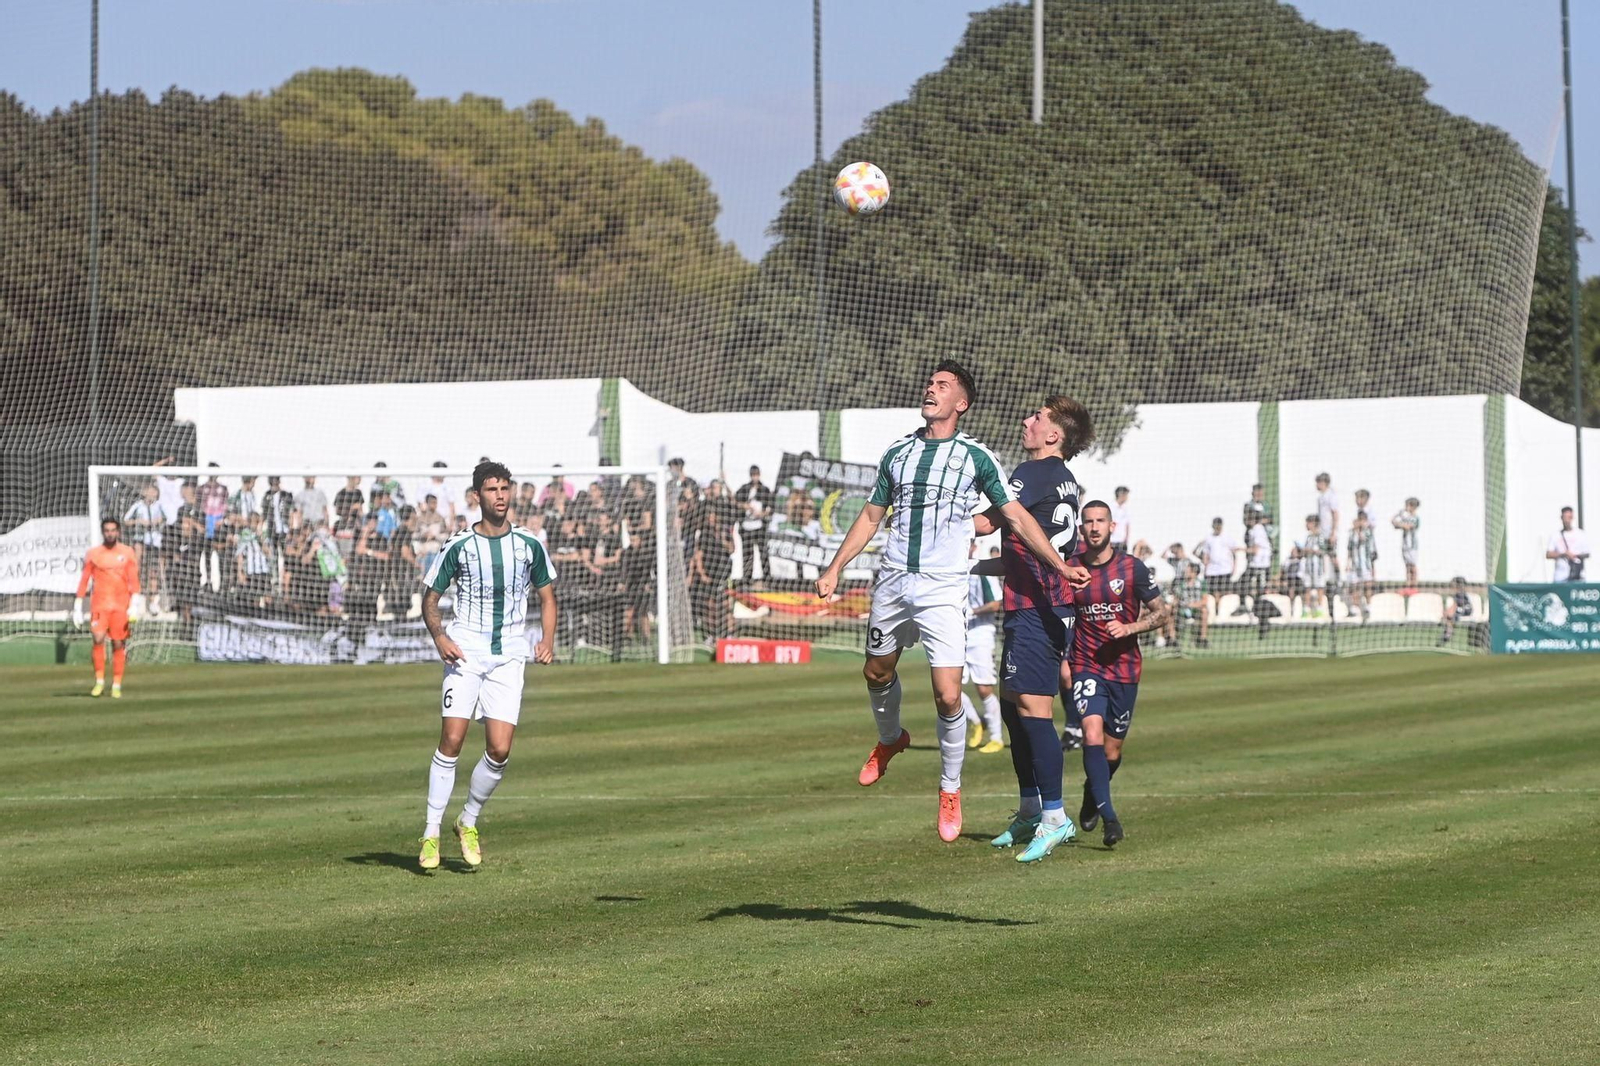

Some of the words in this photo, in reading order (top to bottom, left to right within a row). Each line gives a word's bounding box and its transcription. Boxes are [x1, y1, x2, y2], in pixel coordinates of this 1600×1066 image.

[1049, 502, 1078, 562] 2
[870, 627, 883, 648] 9
[443, 688, 453, 708] 6
[1073, 678, 1097, 700] 23
